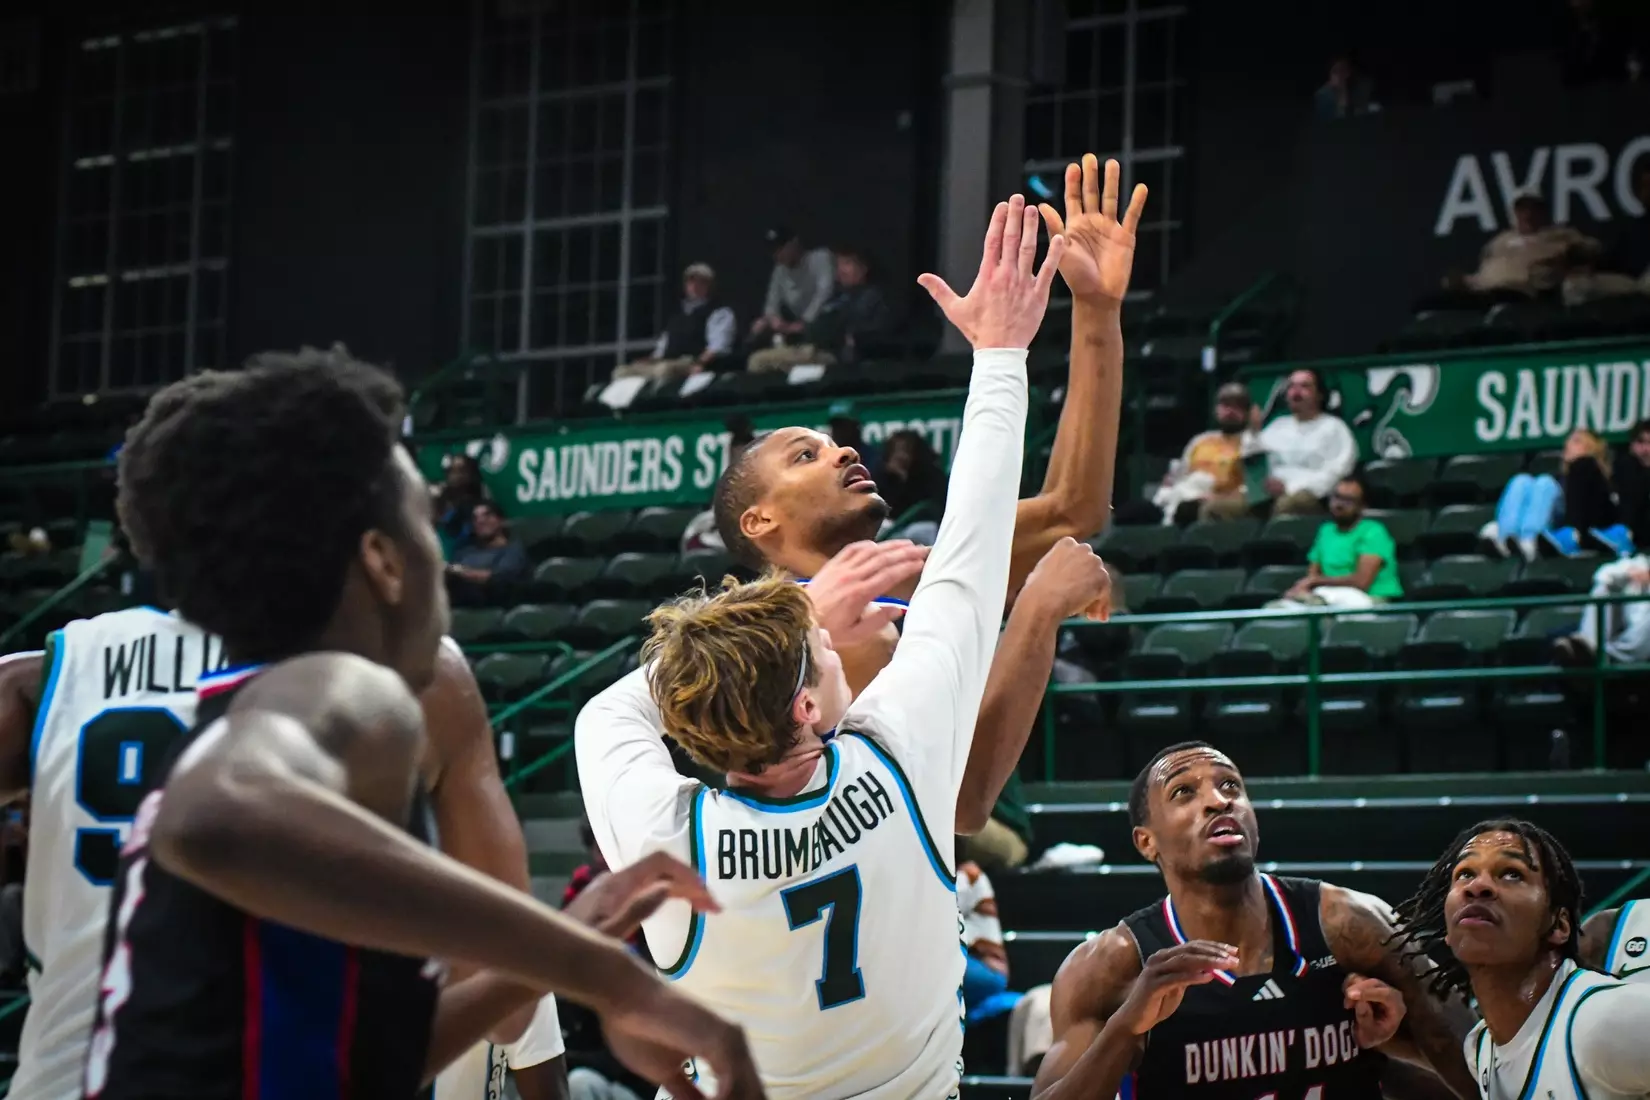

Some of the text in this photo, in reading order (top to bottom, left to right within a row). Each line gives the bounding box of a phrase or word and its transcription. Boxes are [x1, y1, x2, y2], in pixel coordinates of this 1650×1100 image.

[516, 435, 684, 502] SAUNDERS
[74, 707, 188, 886] 9
[718, 770, 894, 880] BRUMBAUGH
[780, 863, 865, 1011] 7
[1184, 1029, 1296, 1084] DUNKIN'
